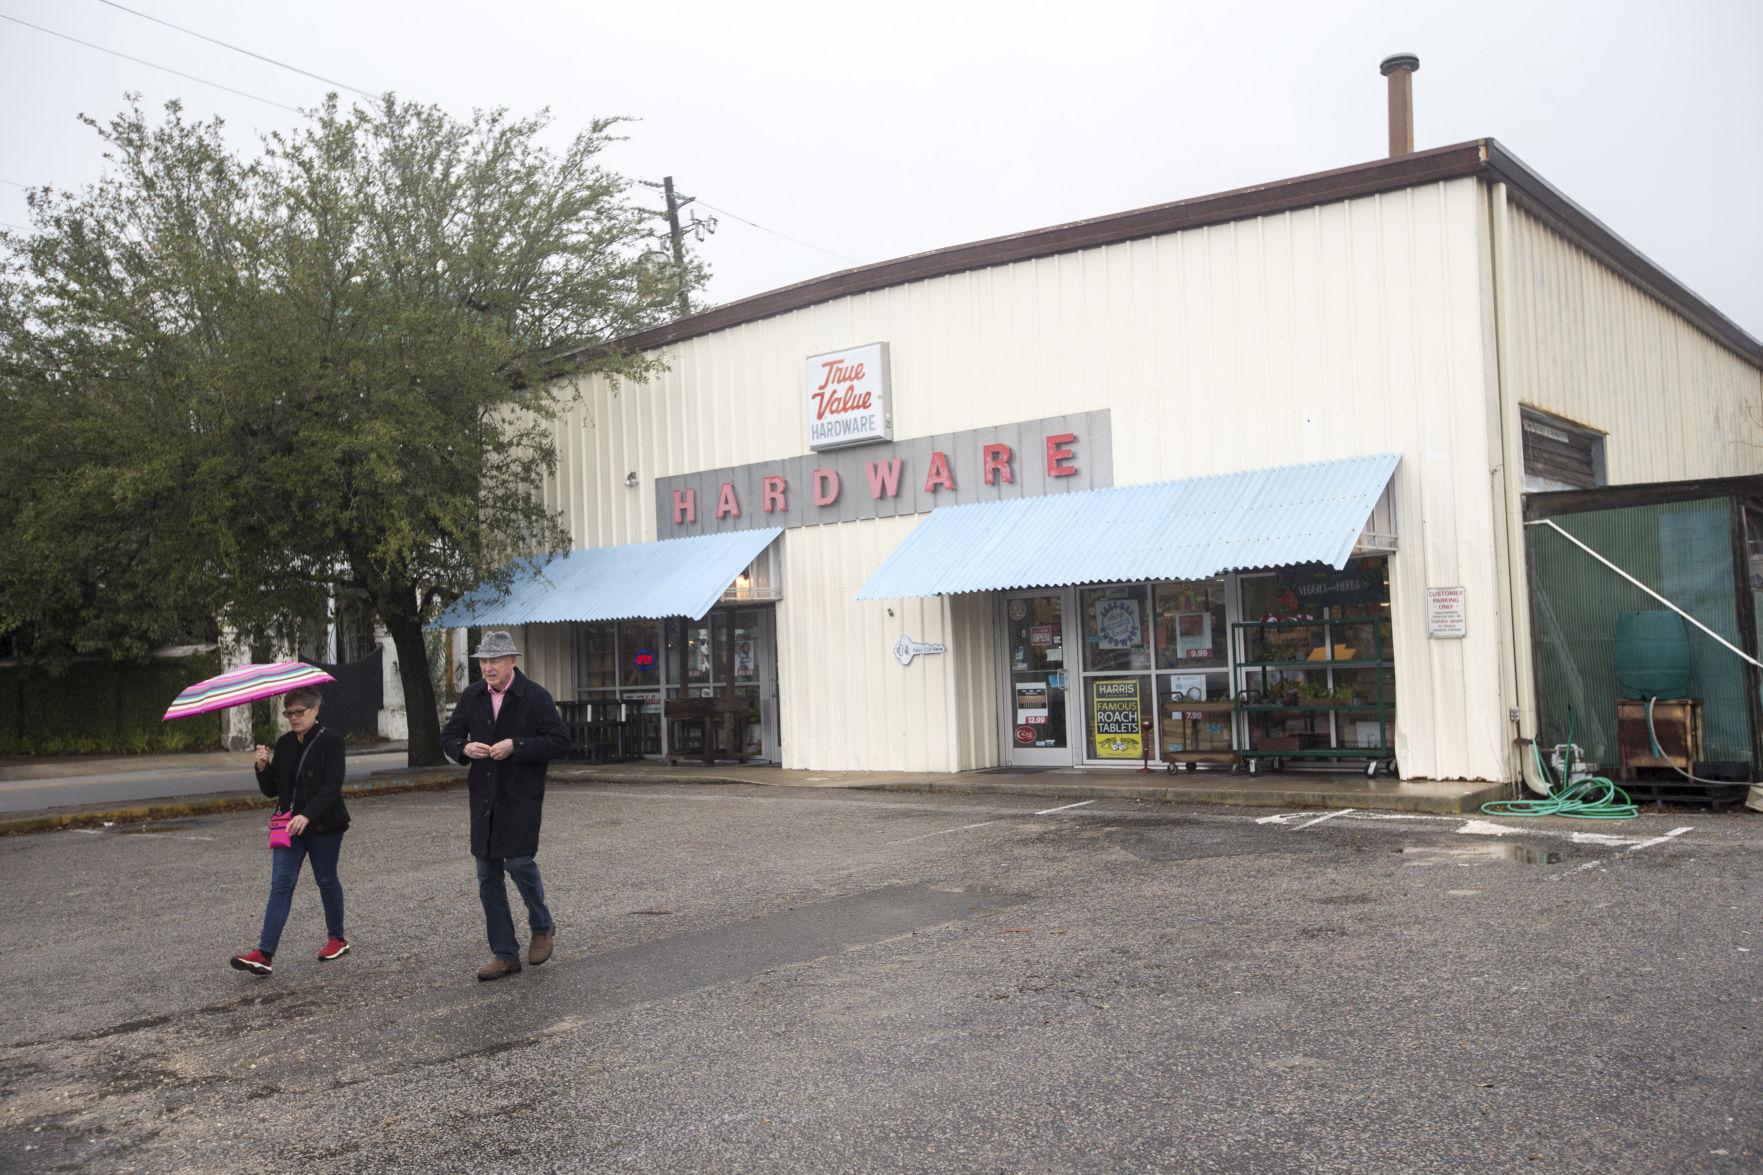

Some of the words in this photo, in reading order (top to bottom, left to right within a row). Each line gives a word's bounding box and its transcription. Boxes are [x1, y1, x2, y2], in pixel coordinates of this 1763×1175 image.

[818, 359, 865, 390] True
[811, 384, 872, 420] Value
[812, 414, 876, 440] HARDWARE
[673, 433, 1077, 524] HARDWARE
[1032, 633, 1050, 642] OPEN
[1190, 649, 1208, 657] 9.99
[1099, 684, 1135, 694] HARRIS
[1097, 702, 1137, 711] FAMOUS
[1027, 716, 1046, 724] 12.99
[1097, 711, 1138, 722] ROACH
[1097, 722, 1138, 733] TABLETS
